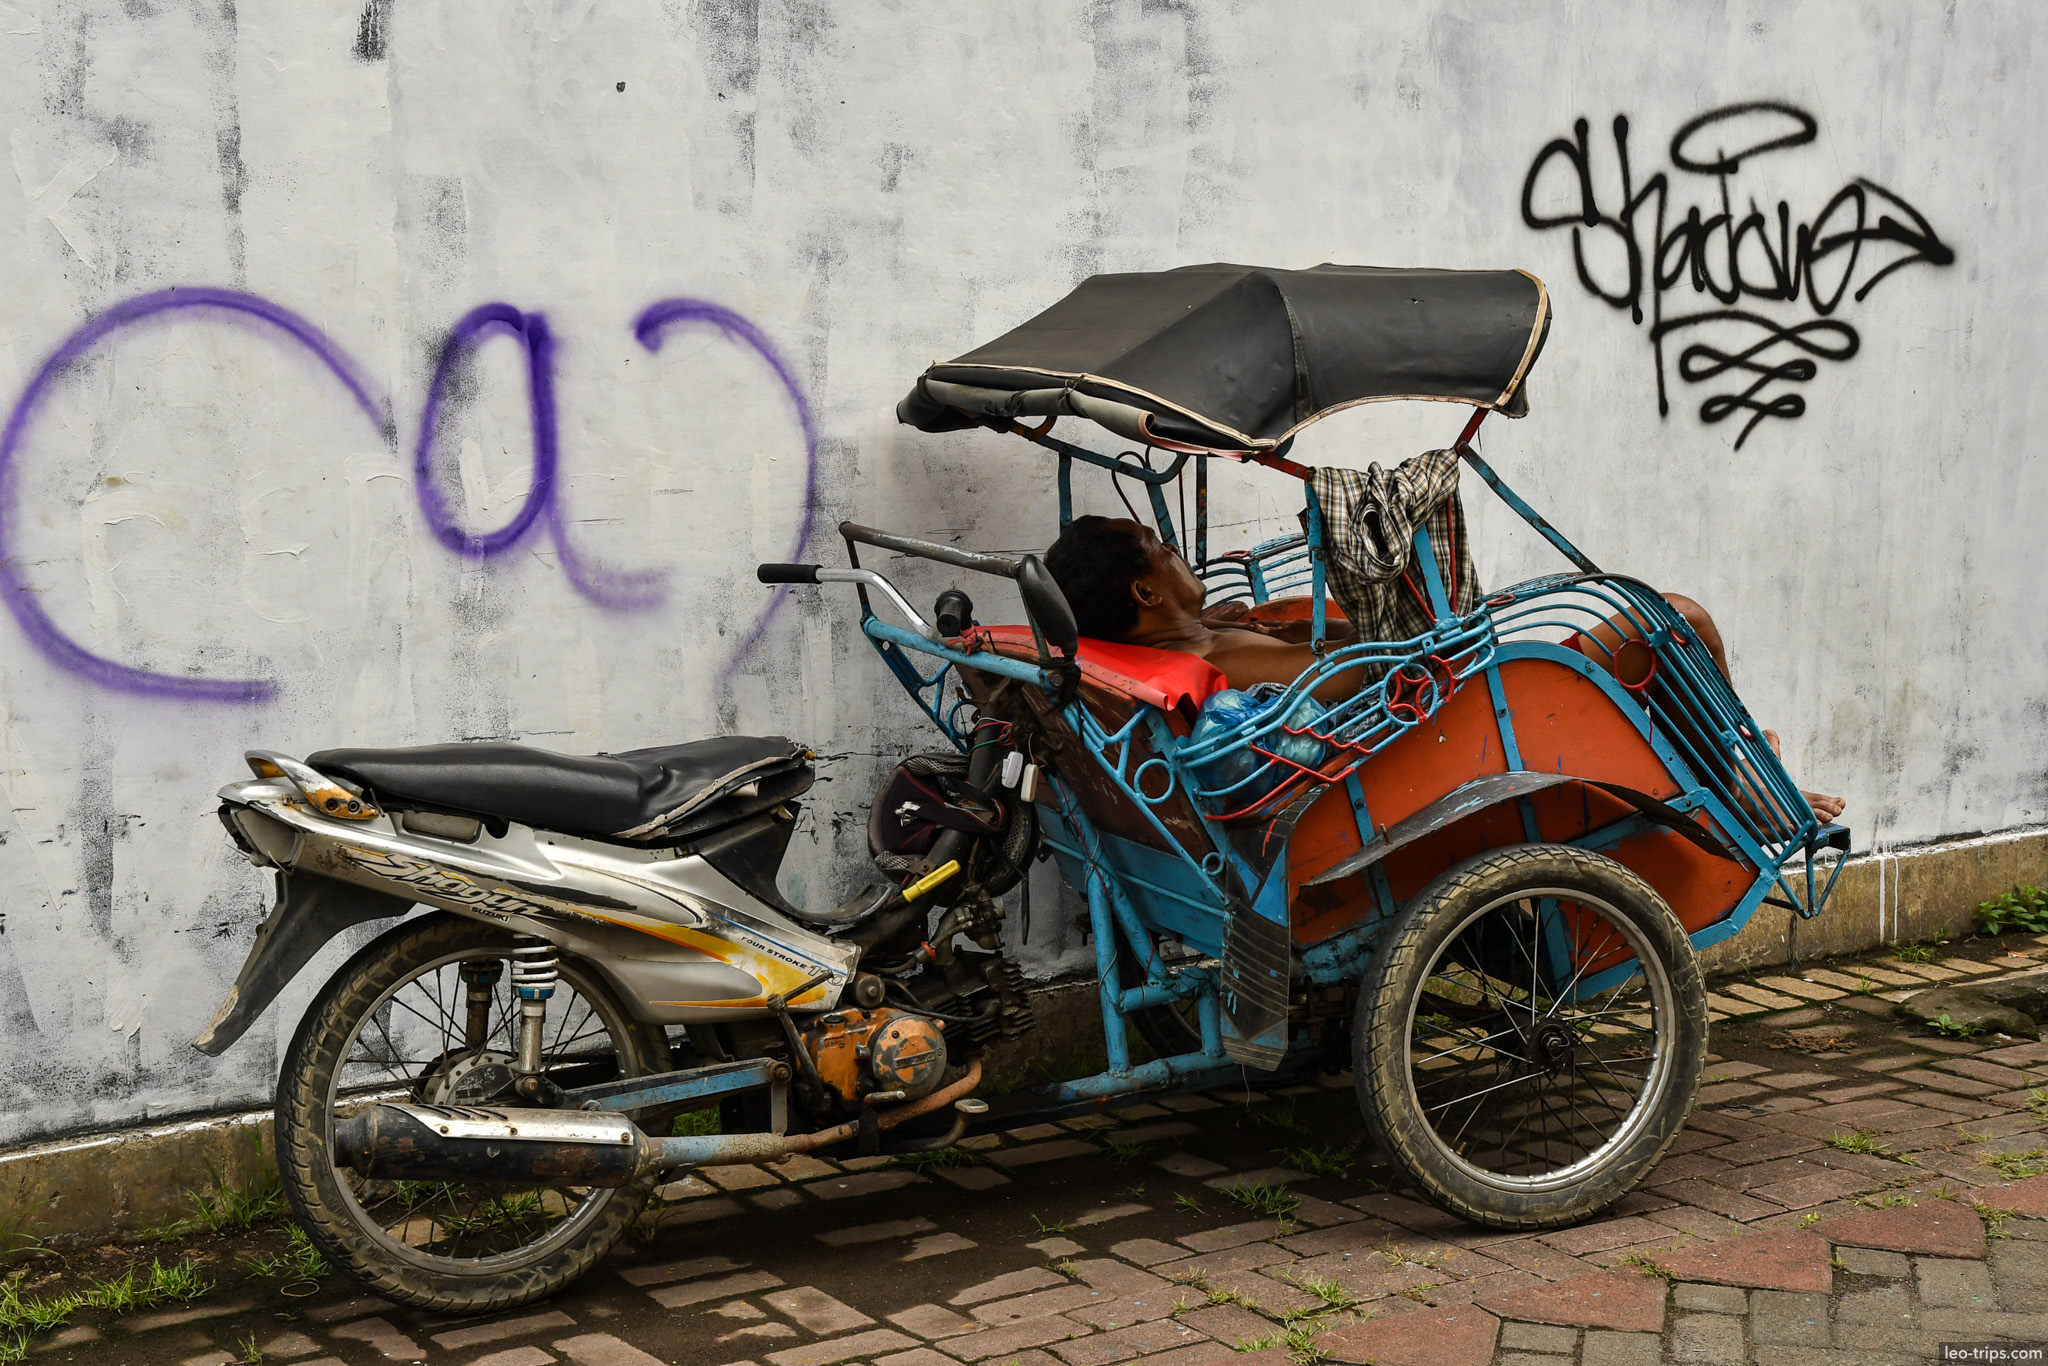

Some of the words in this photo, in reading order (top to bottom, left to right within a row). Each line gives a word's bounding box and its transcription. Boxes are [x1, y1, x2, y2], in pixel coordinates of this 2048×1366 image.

[471, 906, 509, 922] SUZUKI
[740, 936, 766, 951] FOUR
[766, 948, 808, 969] STROKE
